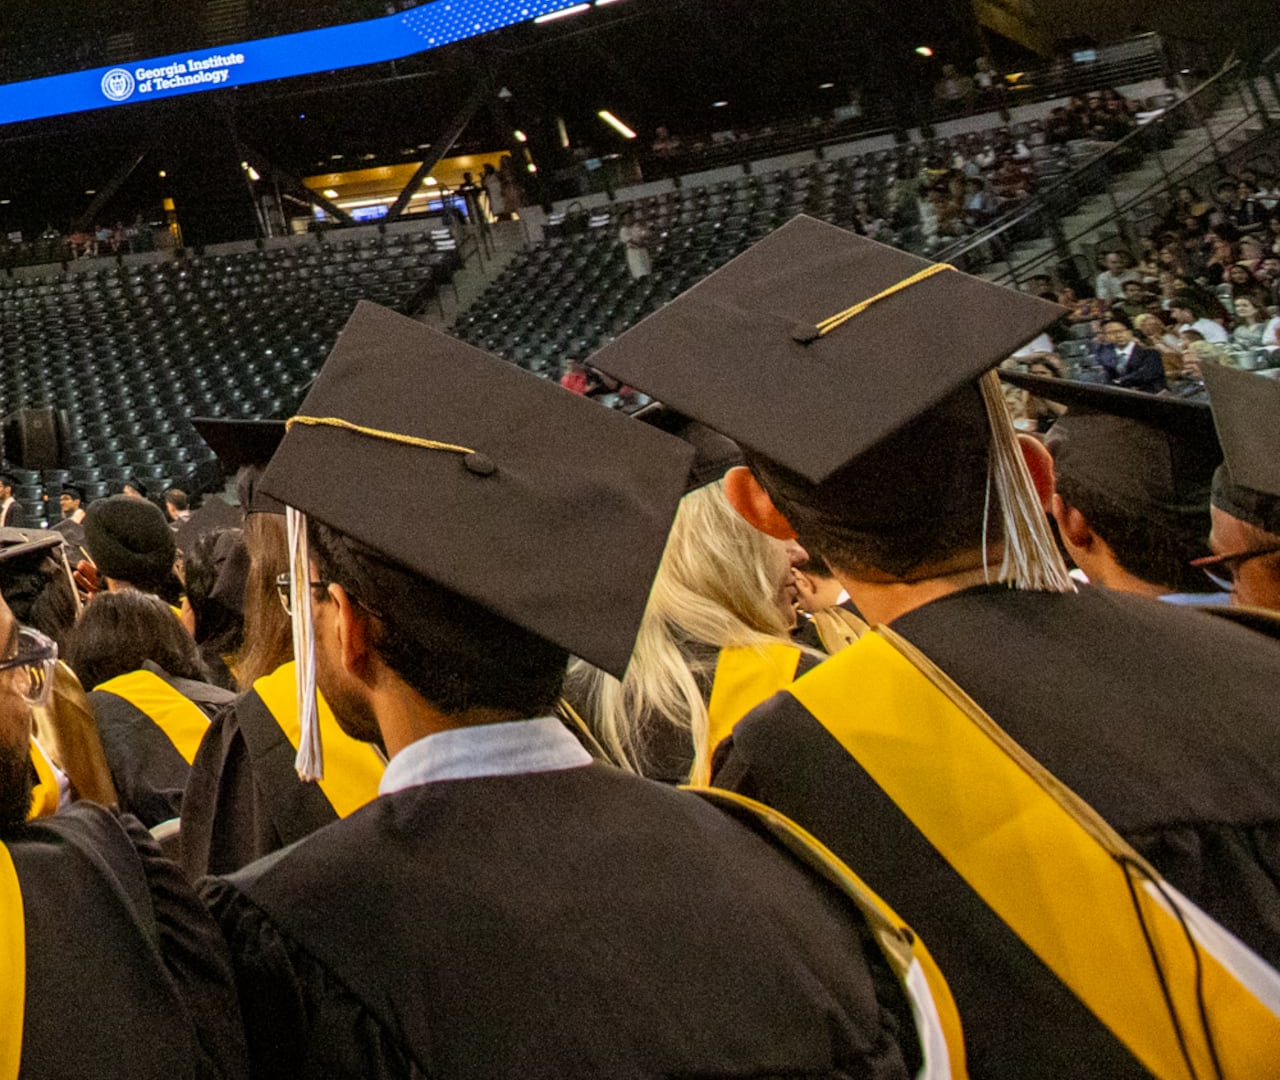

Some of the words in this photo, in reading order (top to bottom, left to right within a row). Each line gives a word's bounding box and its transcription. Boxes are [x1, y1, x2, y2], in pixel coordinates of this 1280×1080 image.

[135, 62, 186, 81] Georgia
[187, 52, 245, 71] Institute
[138, 80, 152, 93] of
[153, 69, 229, 90] Technology
